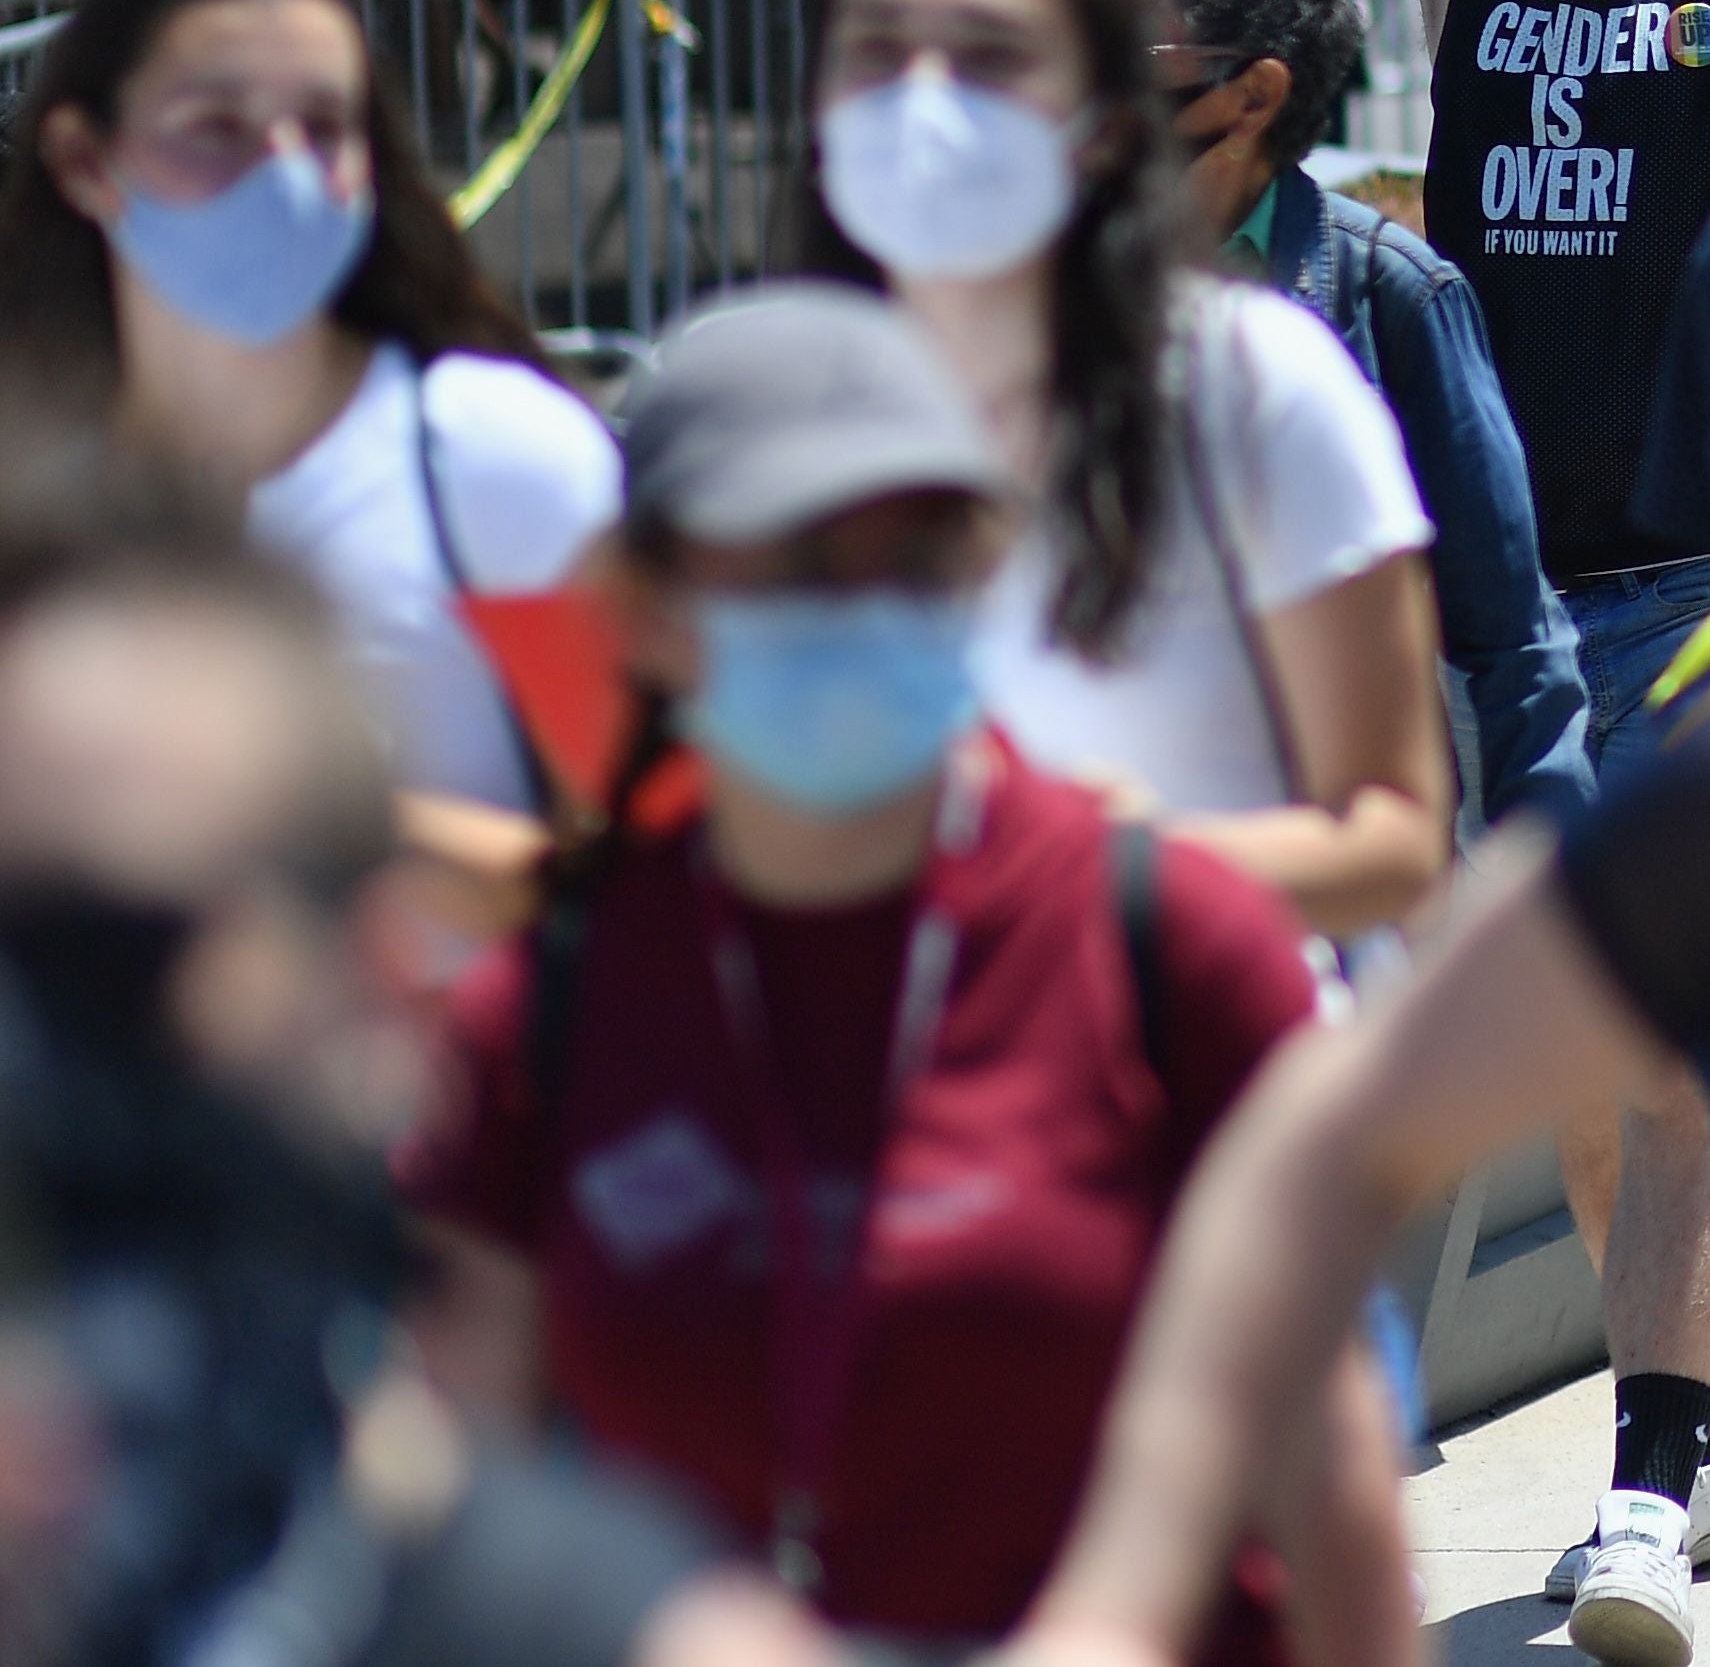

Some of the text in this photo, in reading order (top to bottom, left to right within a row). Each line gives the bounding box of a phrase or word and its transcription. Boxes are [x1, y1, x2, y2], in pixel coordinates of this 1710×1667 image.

[1477, 1, 1669, 77] GENDER
[1678, 11, 1710, 24] RISE
[1531, 74, 1584, 148] IS
[1481, 145, 1634, 222] OVER!
[1484, 230, 1618, 256] IF YOU WANT IT
